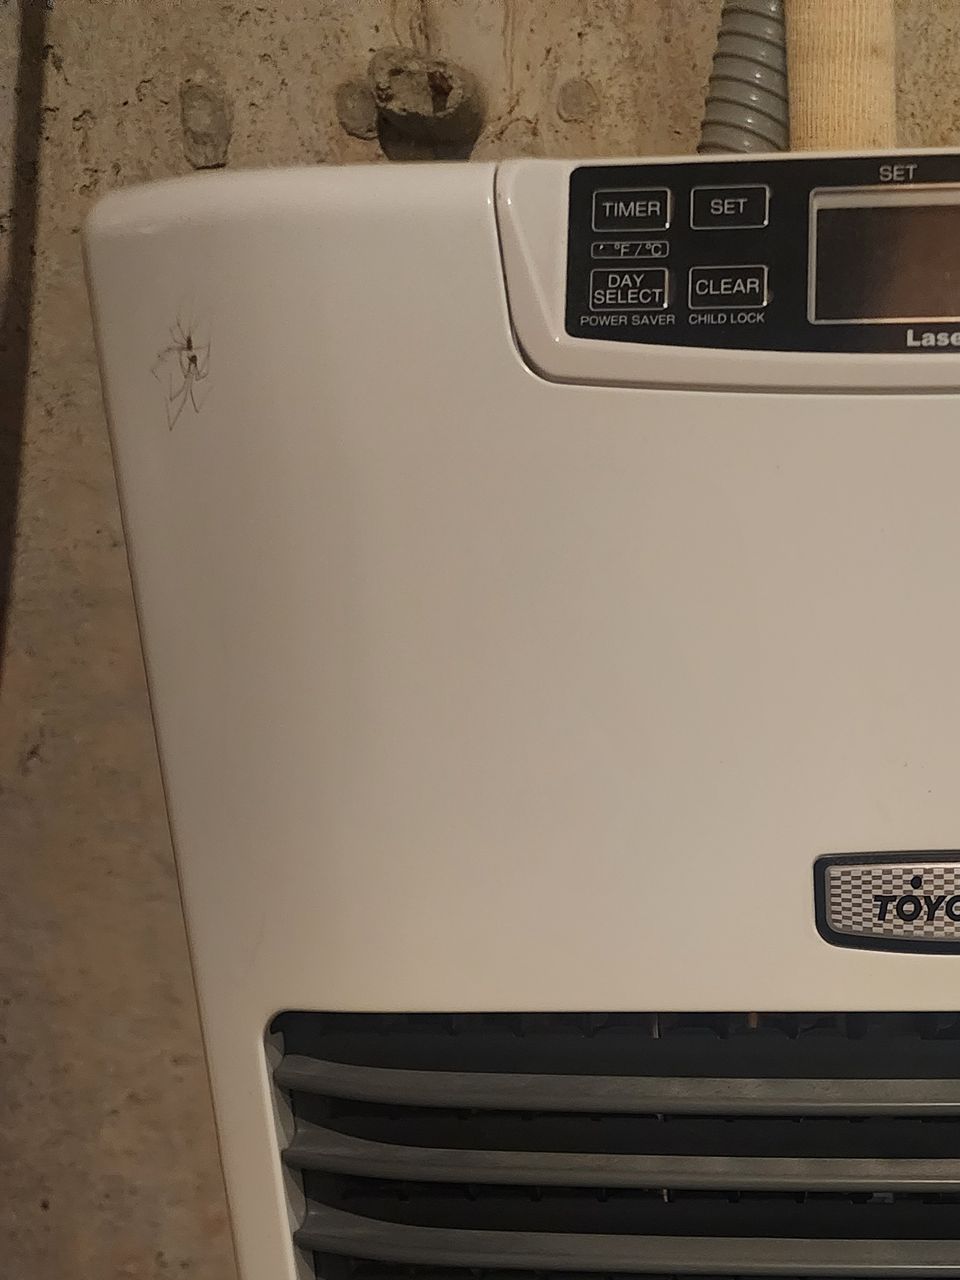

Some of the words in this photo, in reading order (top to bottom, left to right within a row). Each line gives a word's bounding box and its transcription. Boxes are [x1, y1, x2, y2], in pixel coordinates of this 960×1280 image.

[879, 163, 918, 182] SET
[602, 201, 661, 217] TIMER
[710, 198, 748, 215] SET
[608, 273, 645, 288] DAY
[695, 278, 760, 295] CLEAR
[593, 289, 663, 304] SELECT
[580, 315, 628, 327] POWER
[631, 314, 676, 326] SAVER
[688, 313, 727, 325] CHILD
[730, 312, 765, 325] LOCK
